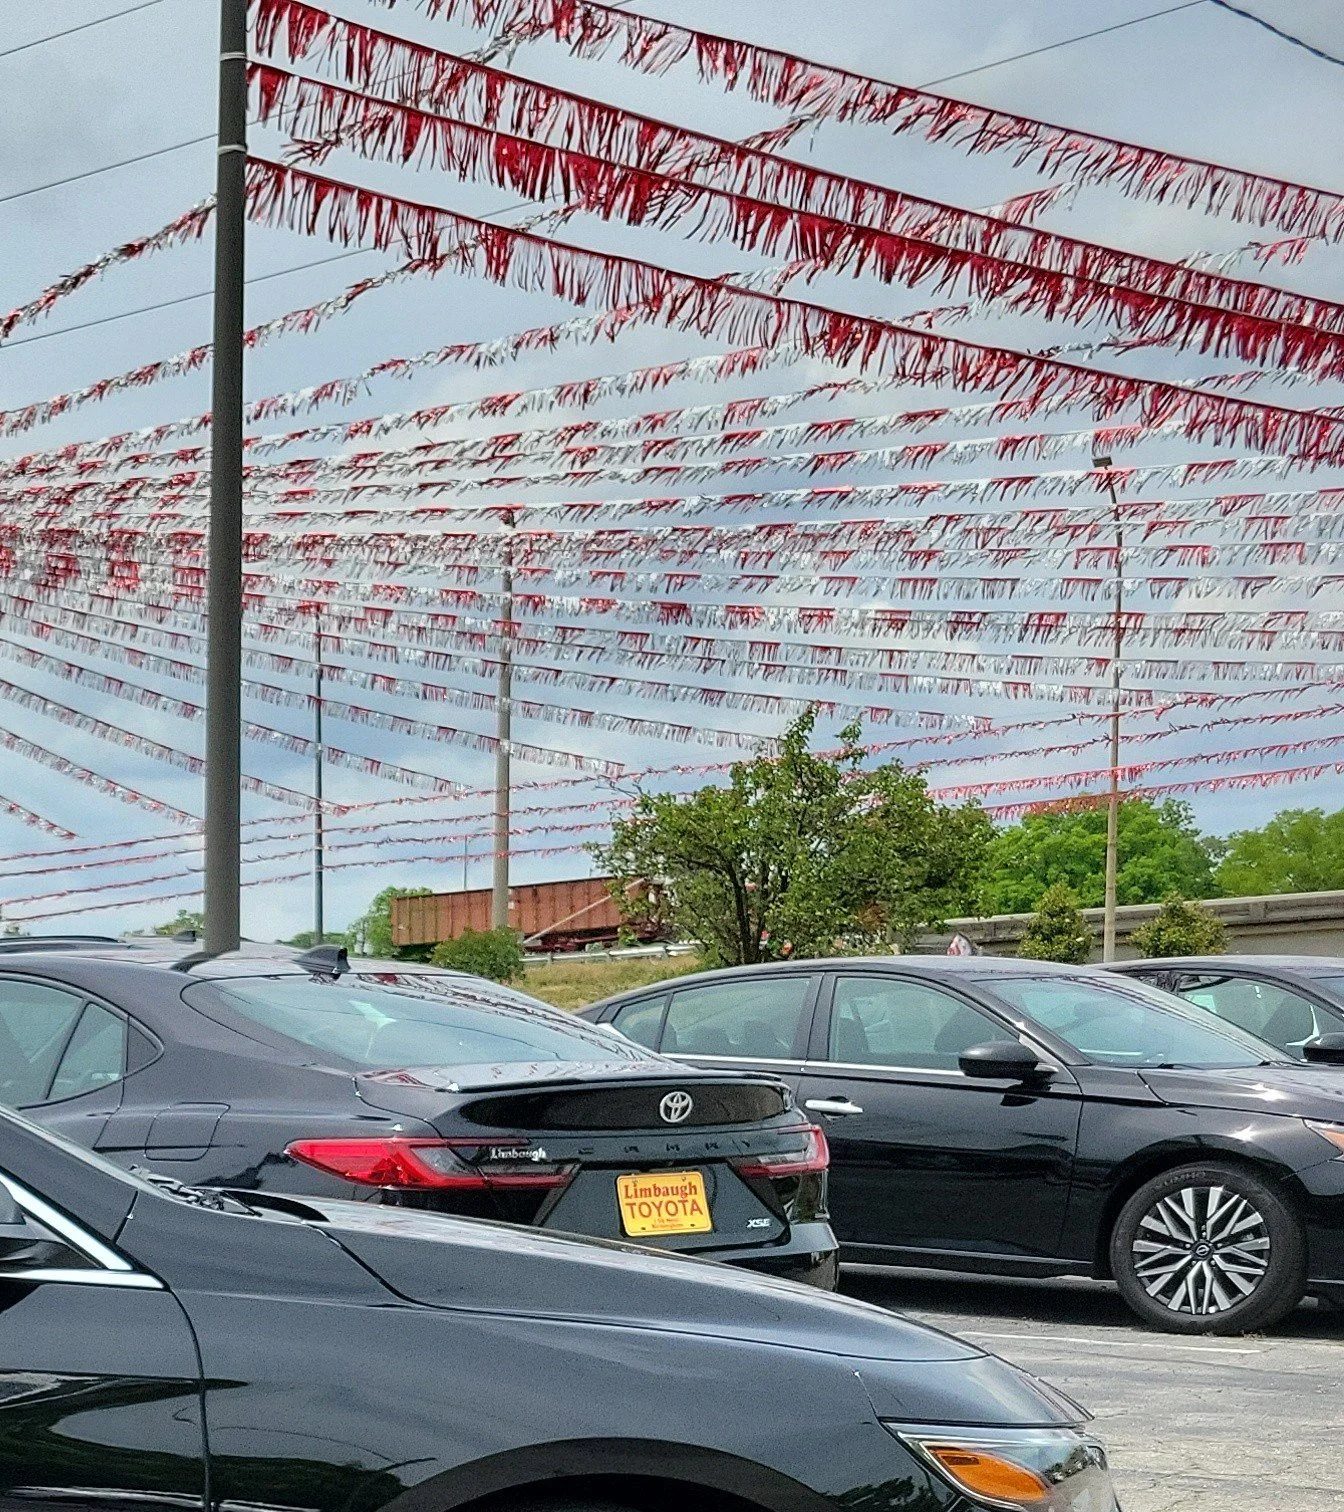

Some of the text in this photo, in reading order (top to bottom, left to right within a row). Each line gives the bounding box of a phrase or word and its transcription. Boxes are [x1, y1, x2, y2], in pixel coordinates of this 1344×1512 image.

[624, 1181, 698, 1199] Limbaugh
[625, 1198, 703, 1219] TOYOTA
[746, 1218, 771, 1228] XSE
